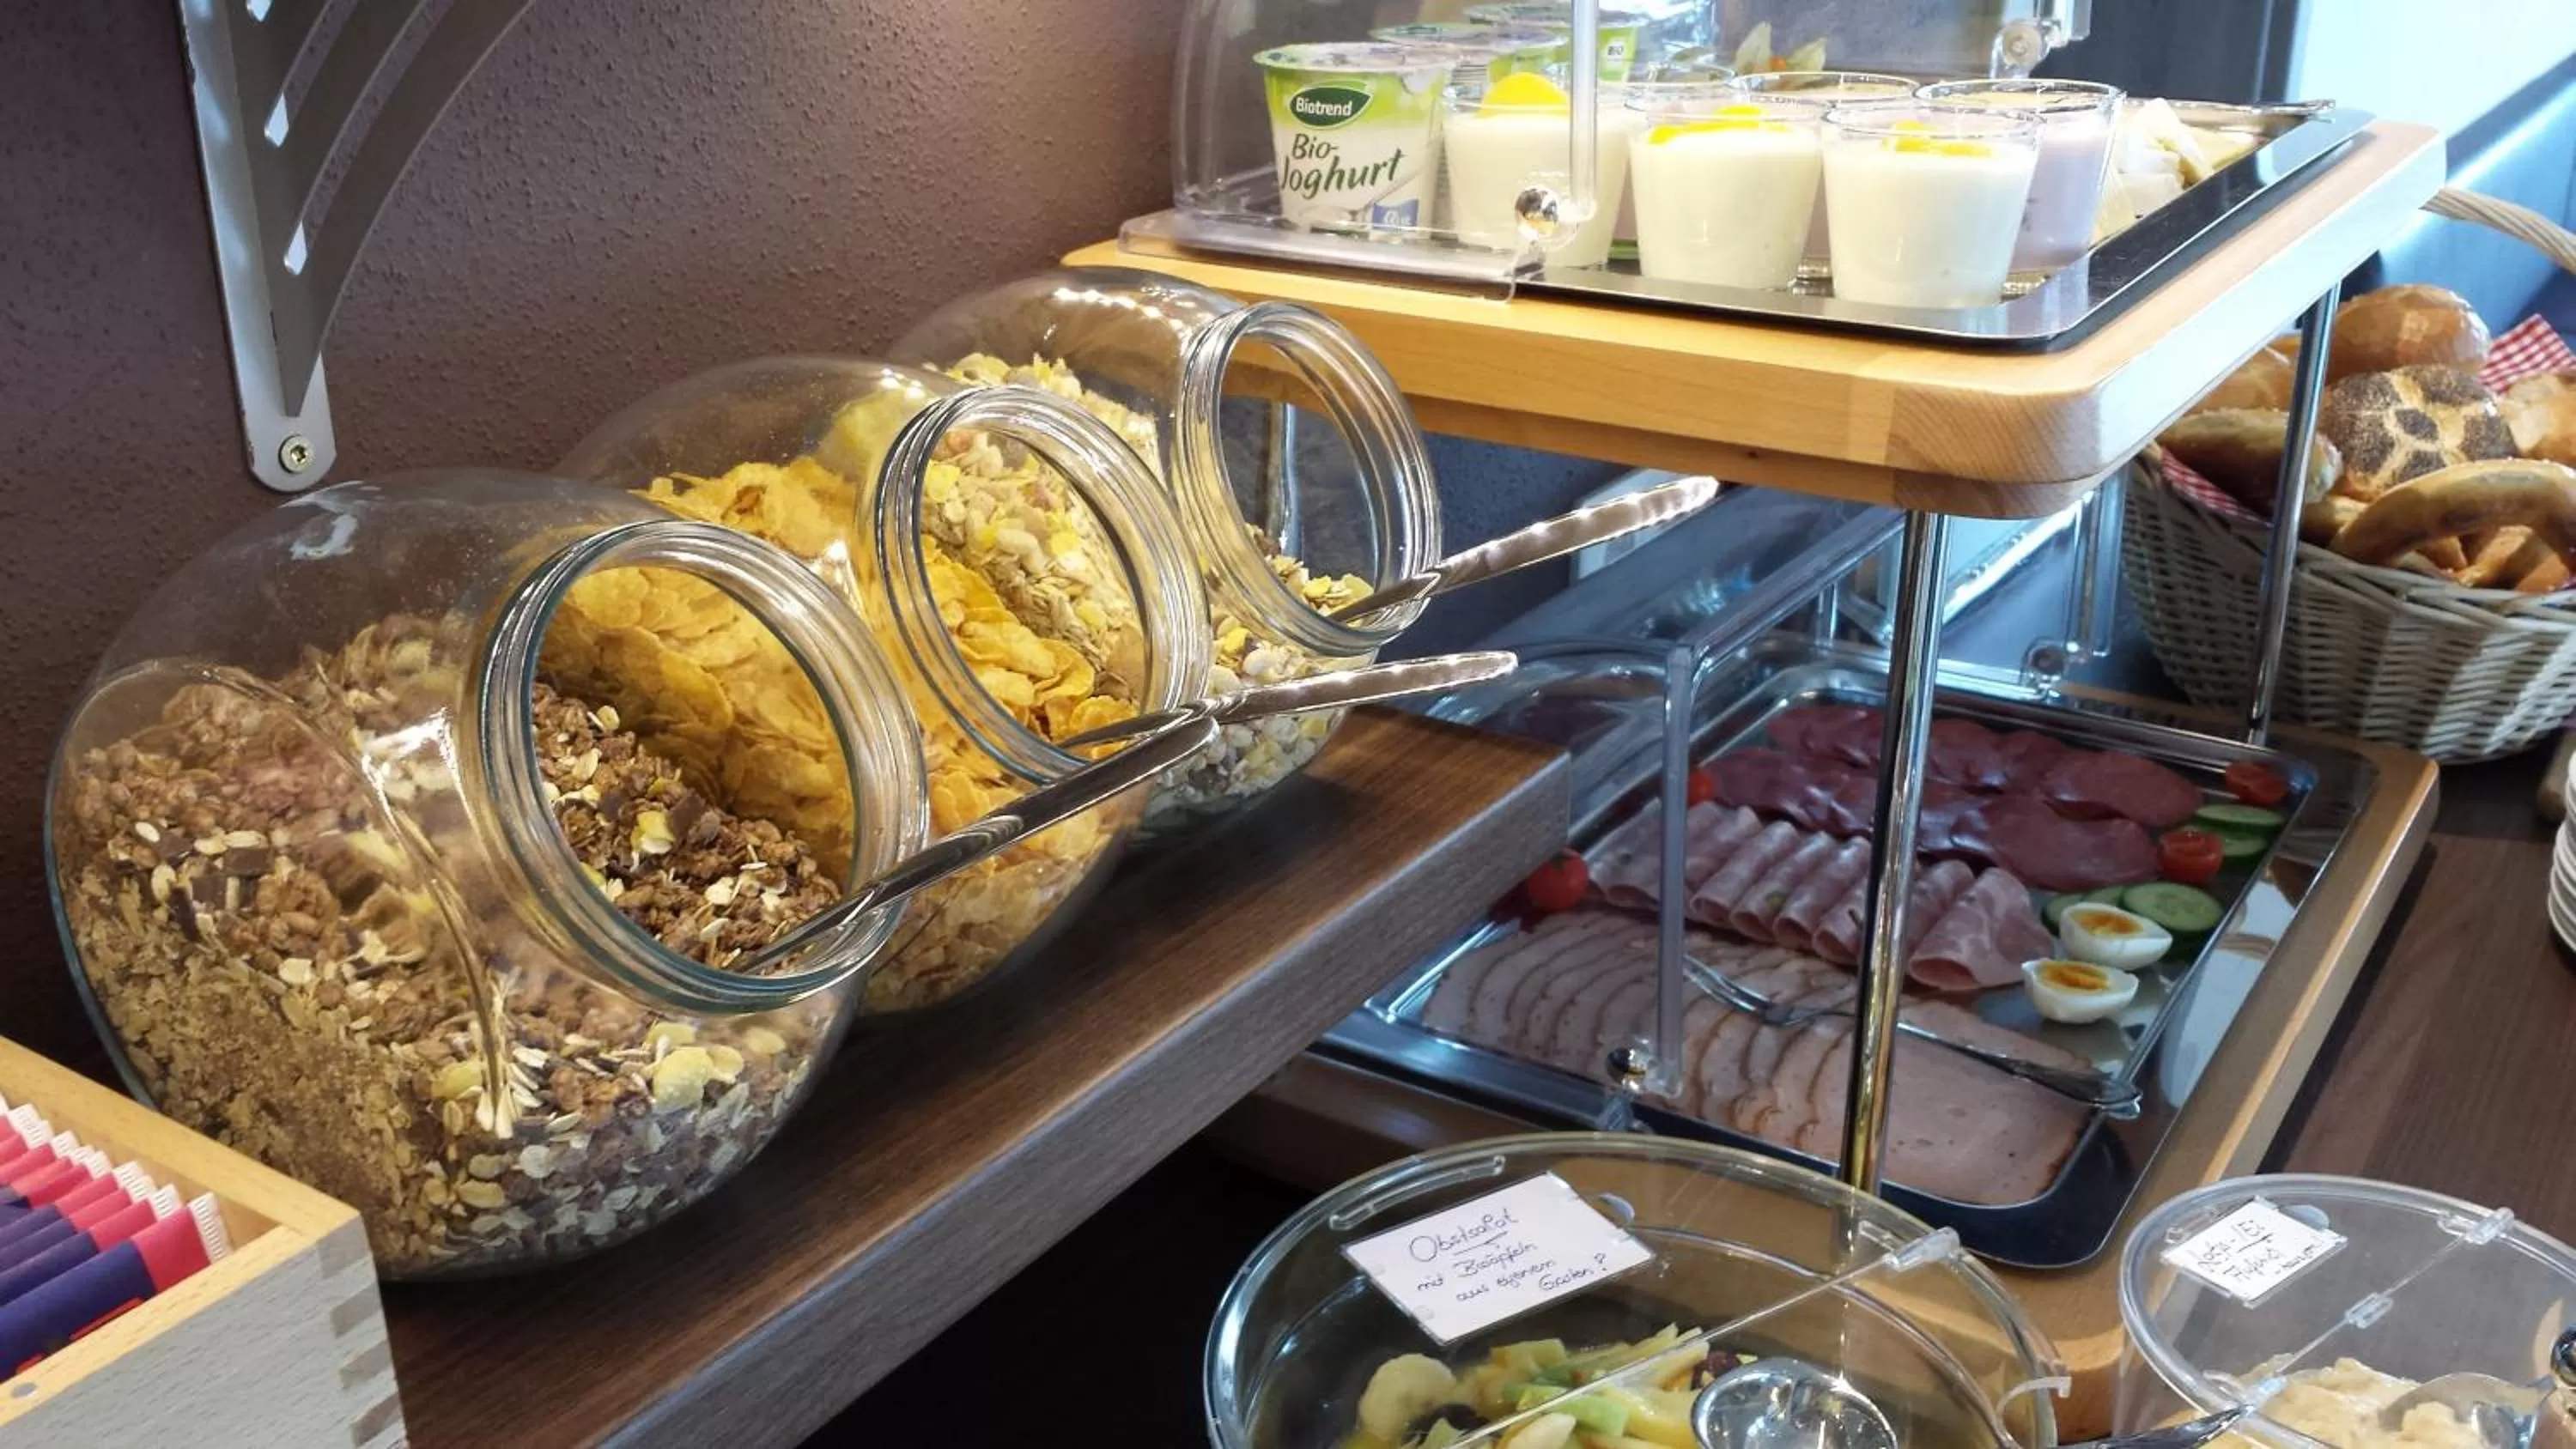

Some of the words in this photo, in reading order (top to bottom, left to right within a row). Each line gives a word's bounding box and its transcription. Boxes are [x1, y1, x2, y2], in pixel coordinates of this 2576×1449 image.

[1296, 97, 1353, 117] Biotrend
[1292, 133, 1340, 161] Bio-
[1281, 148, 1407, 200] Joghurt
[1409, 1208, 1519, 1262] Obstsalat
